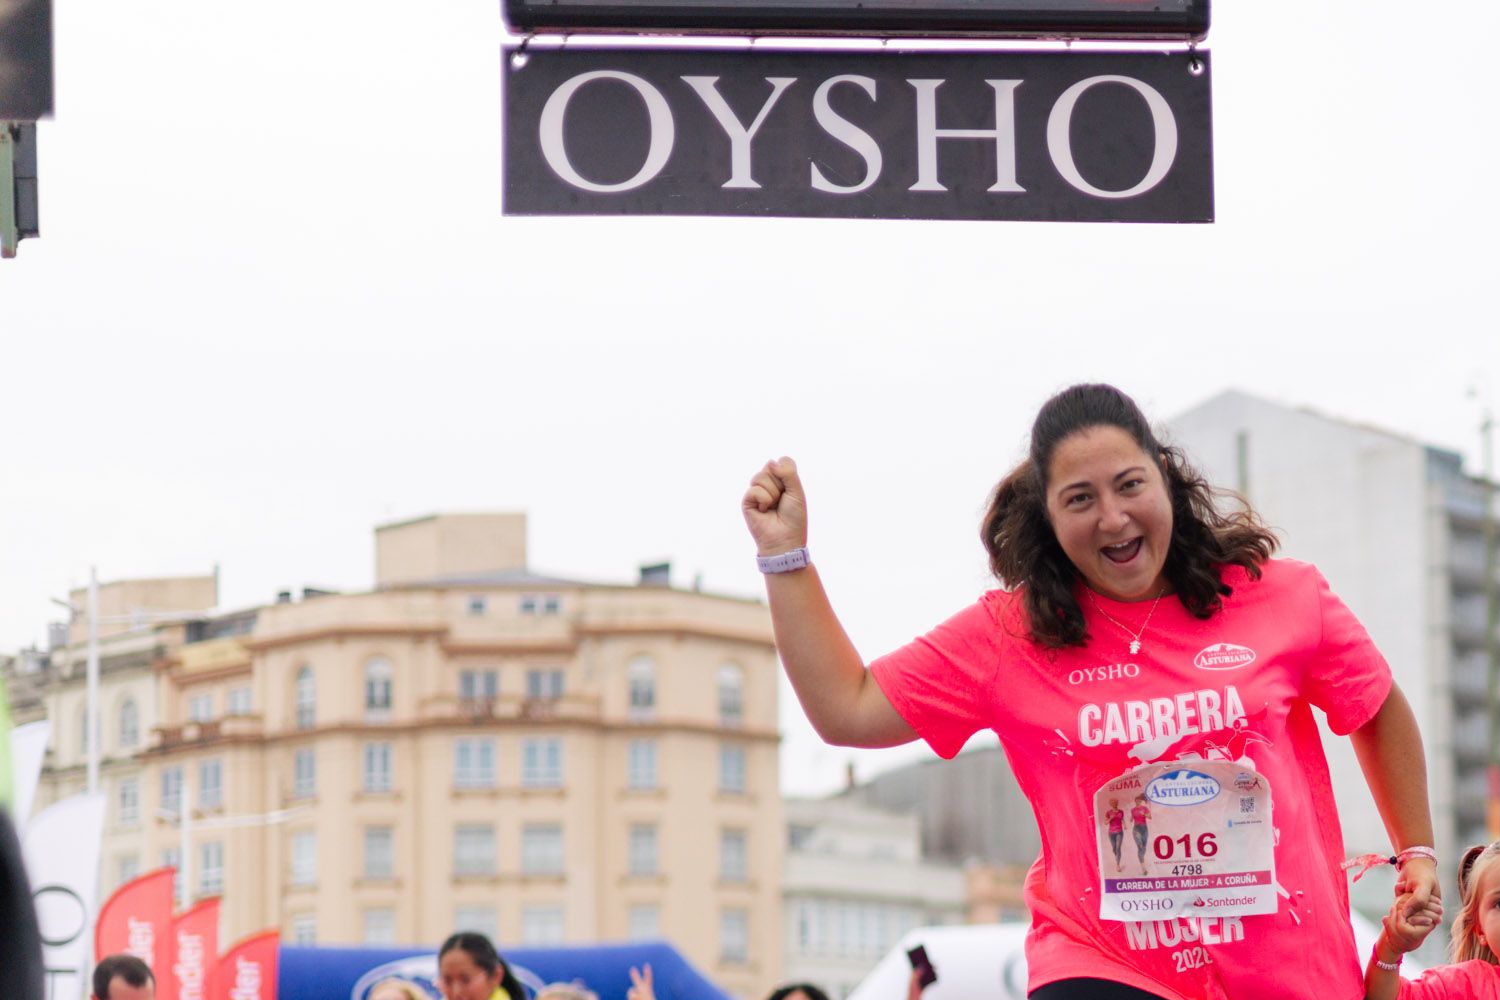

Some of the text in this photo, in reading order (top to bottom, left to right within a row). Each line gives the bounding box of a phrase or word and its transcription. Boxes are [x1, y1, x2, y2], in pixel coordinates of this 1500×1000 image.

[538, 69, 1178, 198] OYSHO
[1200, 653, 1252, 667] ASTURIANA
[1068, 663, 1140, 685] OYSHO
[1078, 685, 1248, 748] CARRERA
[1150, 783, 1215, 799] ASTURIANA
[1153, 832, 1218, 860] 016
[1172, 864, 1203, 877] 4798
[1116, 881, 1153, 891] CARRERA
[1155, 880, 1166, 889] DE
[1168, 880, 1179, 889] LA
[1180, 877, 1209, 888] MUJER
[1216, 877, 1223, 886] A
[1224, 874, 1258, 885] CORUÑA
[1121, 898, 1174, 912] OYSHO
[1207, 896, 1257, 908] Santander
[1124, 916, 1245, 951] MUJER
